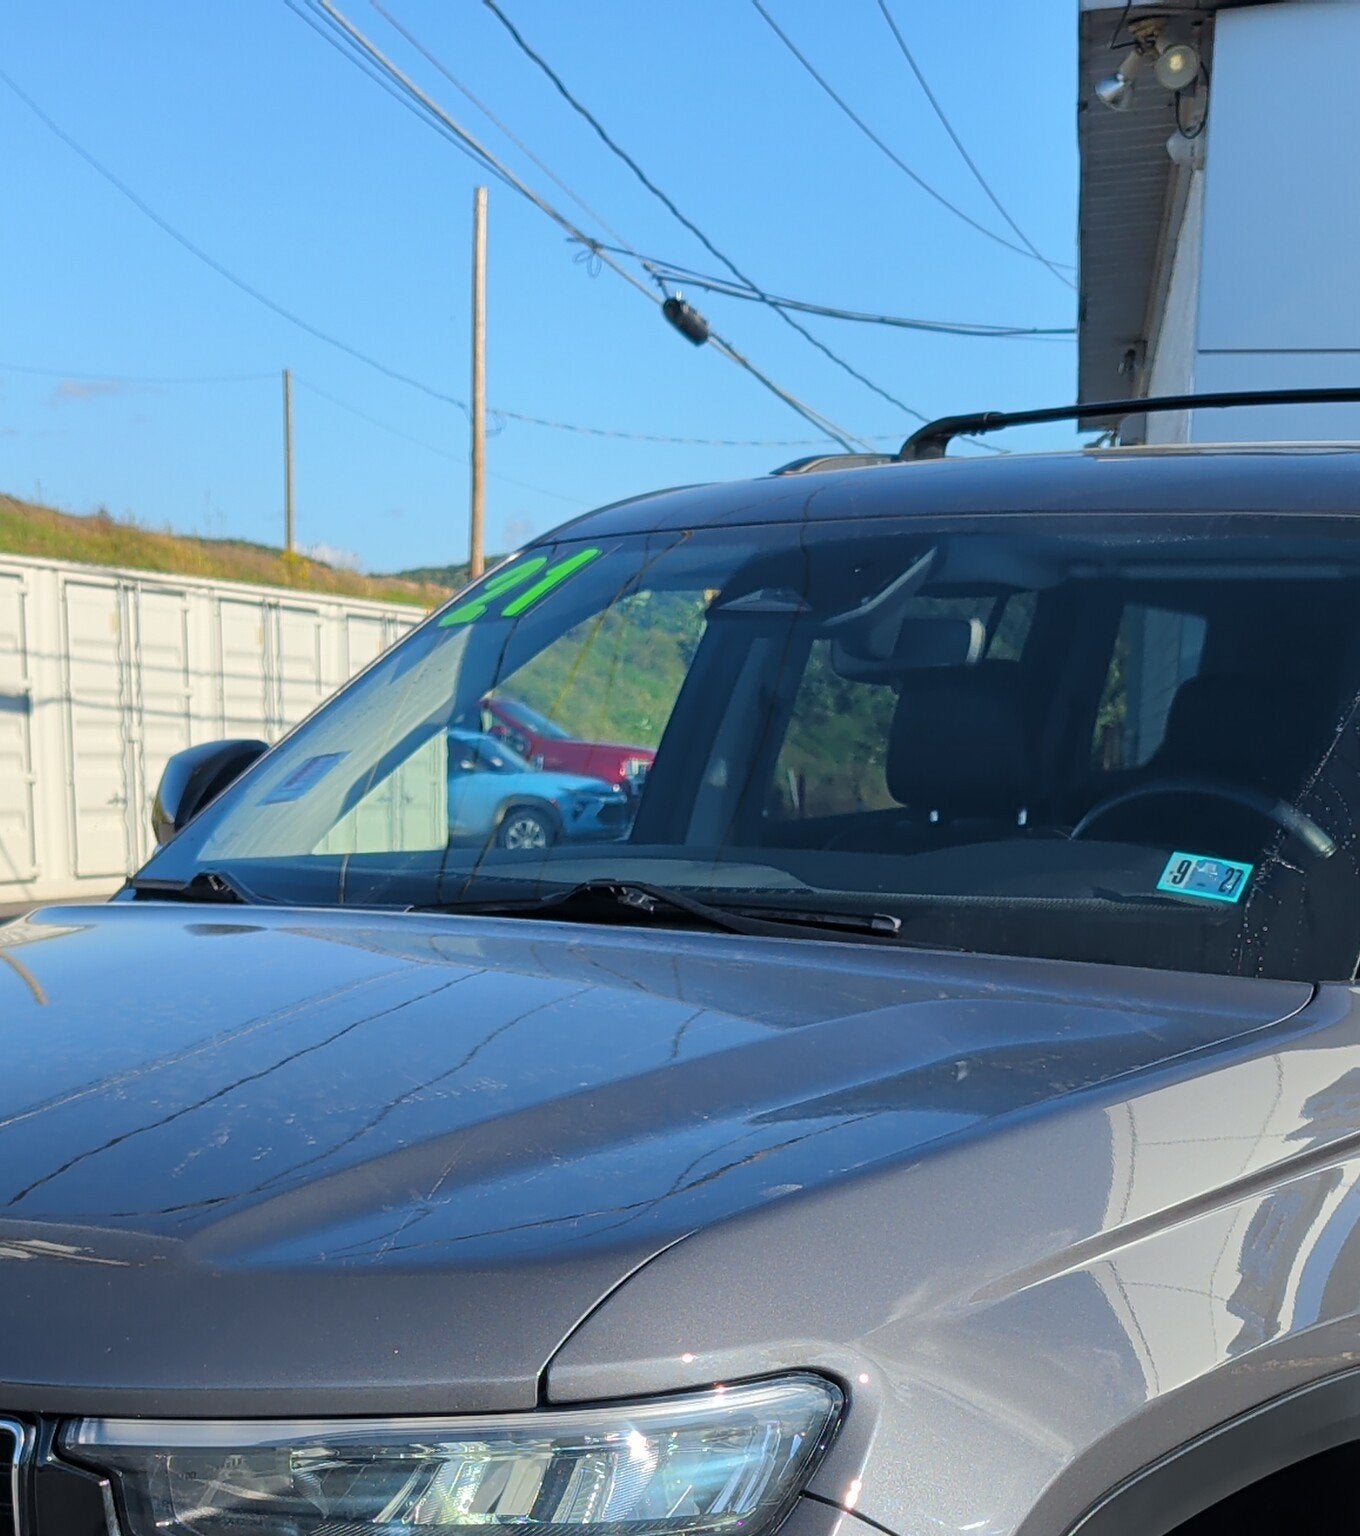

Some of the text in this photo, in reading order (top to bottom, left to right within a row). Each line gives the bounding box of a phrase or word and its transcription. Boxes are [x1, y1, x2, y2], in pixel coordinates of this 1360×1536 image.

[438, 548, 602, 627] 21
[1171, 859, 1192, 885] 9
[1218, 867, 1245, 895] 27
